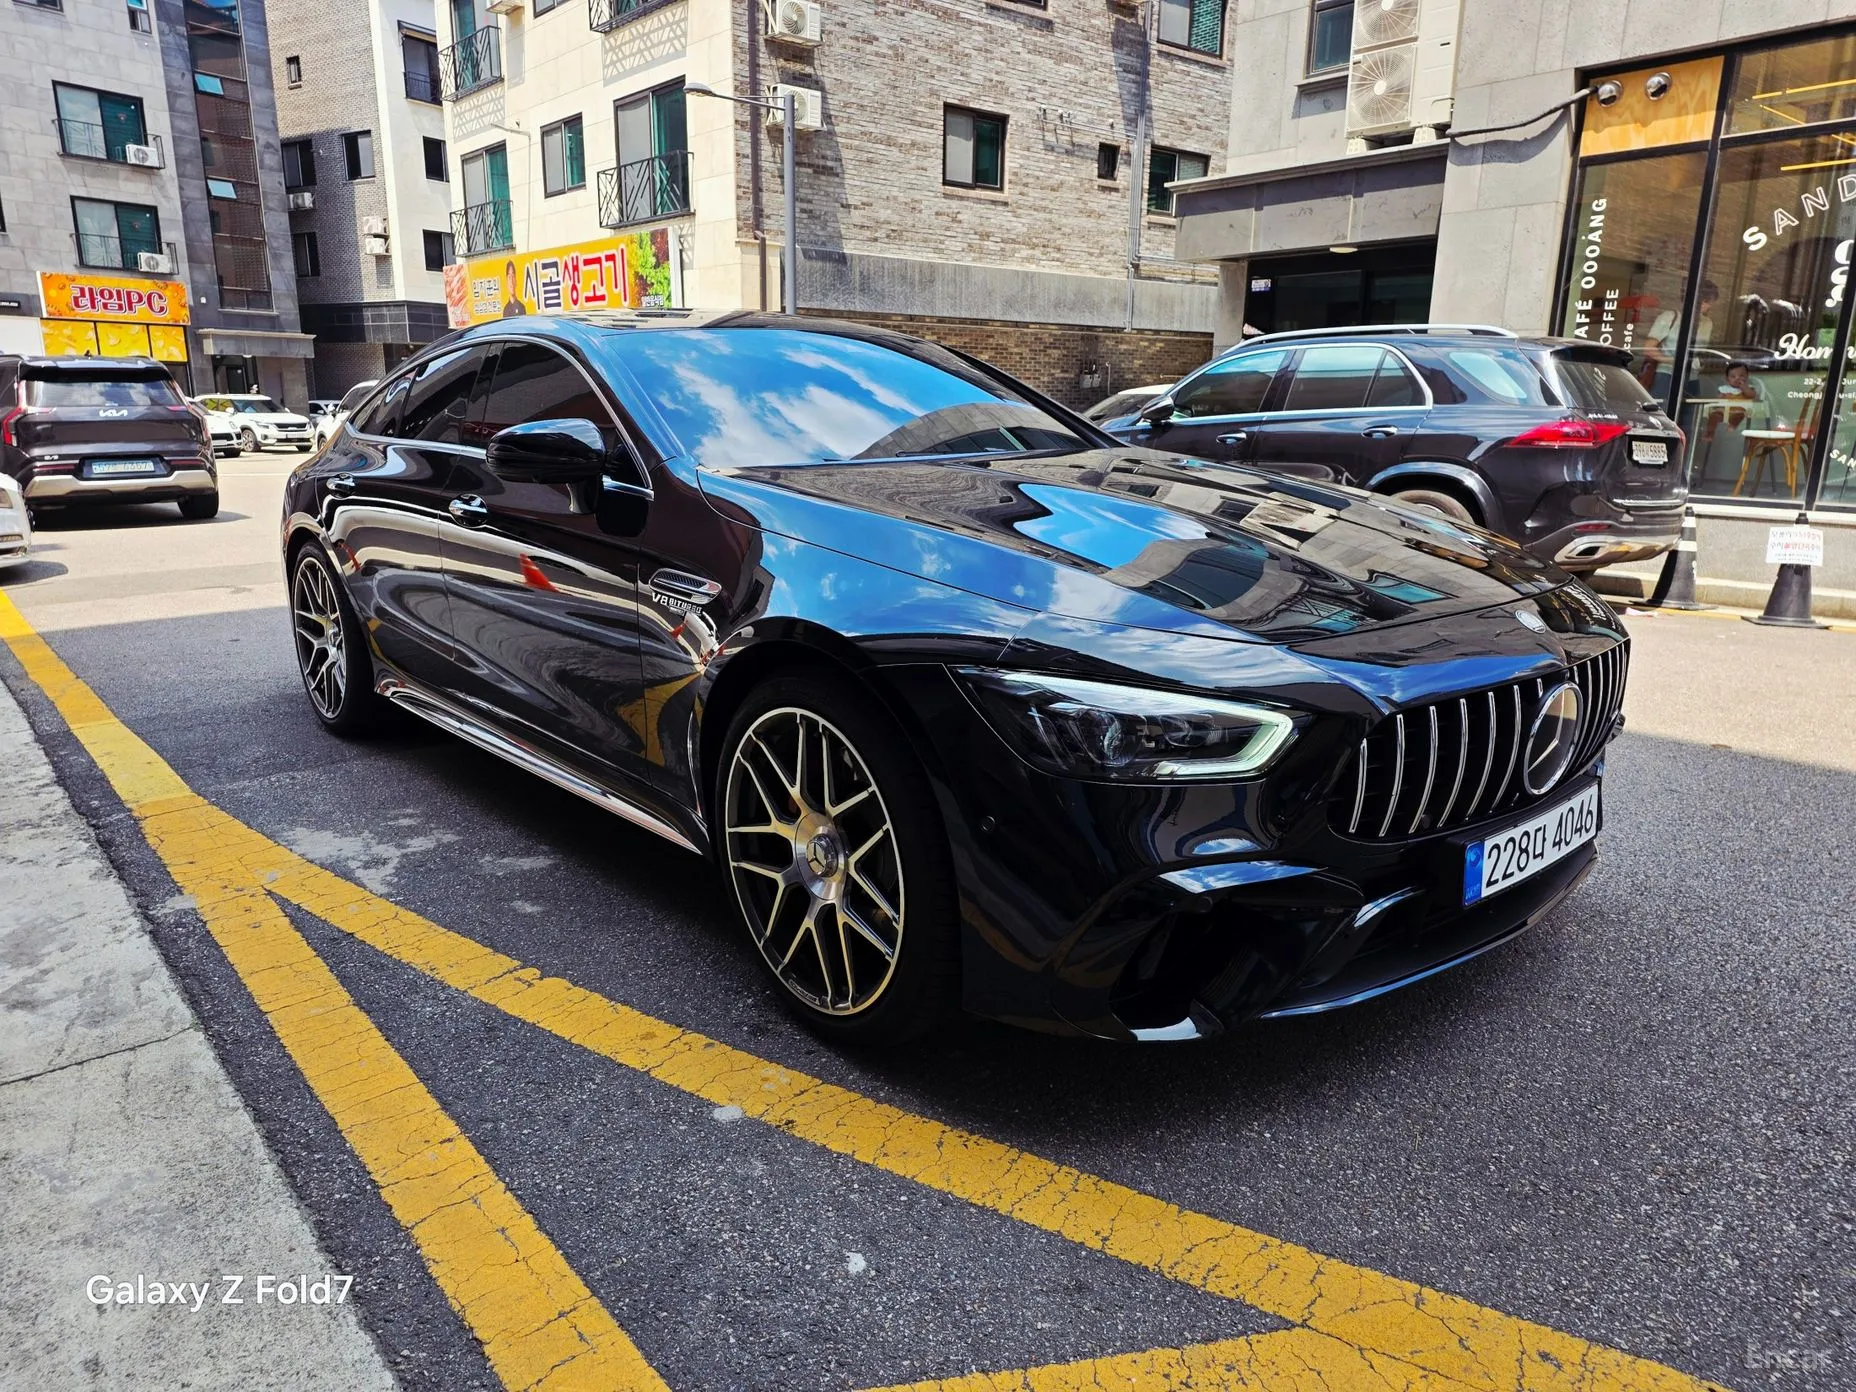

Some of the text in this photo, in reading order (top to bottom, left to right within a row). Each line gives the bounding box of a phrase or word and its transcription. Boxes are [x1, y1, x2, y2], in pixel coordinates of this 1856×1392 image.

[70, 284, 168, 317] 라임PC
[524, 245, 628, 311] 시골생고기
[1574, 299, 1593, 338] AFÉ
[1600, 288, 1619, 346] OFFEE
[651, 592, 669, 606] V8
[1551, 794, 1594, 852] 4046
